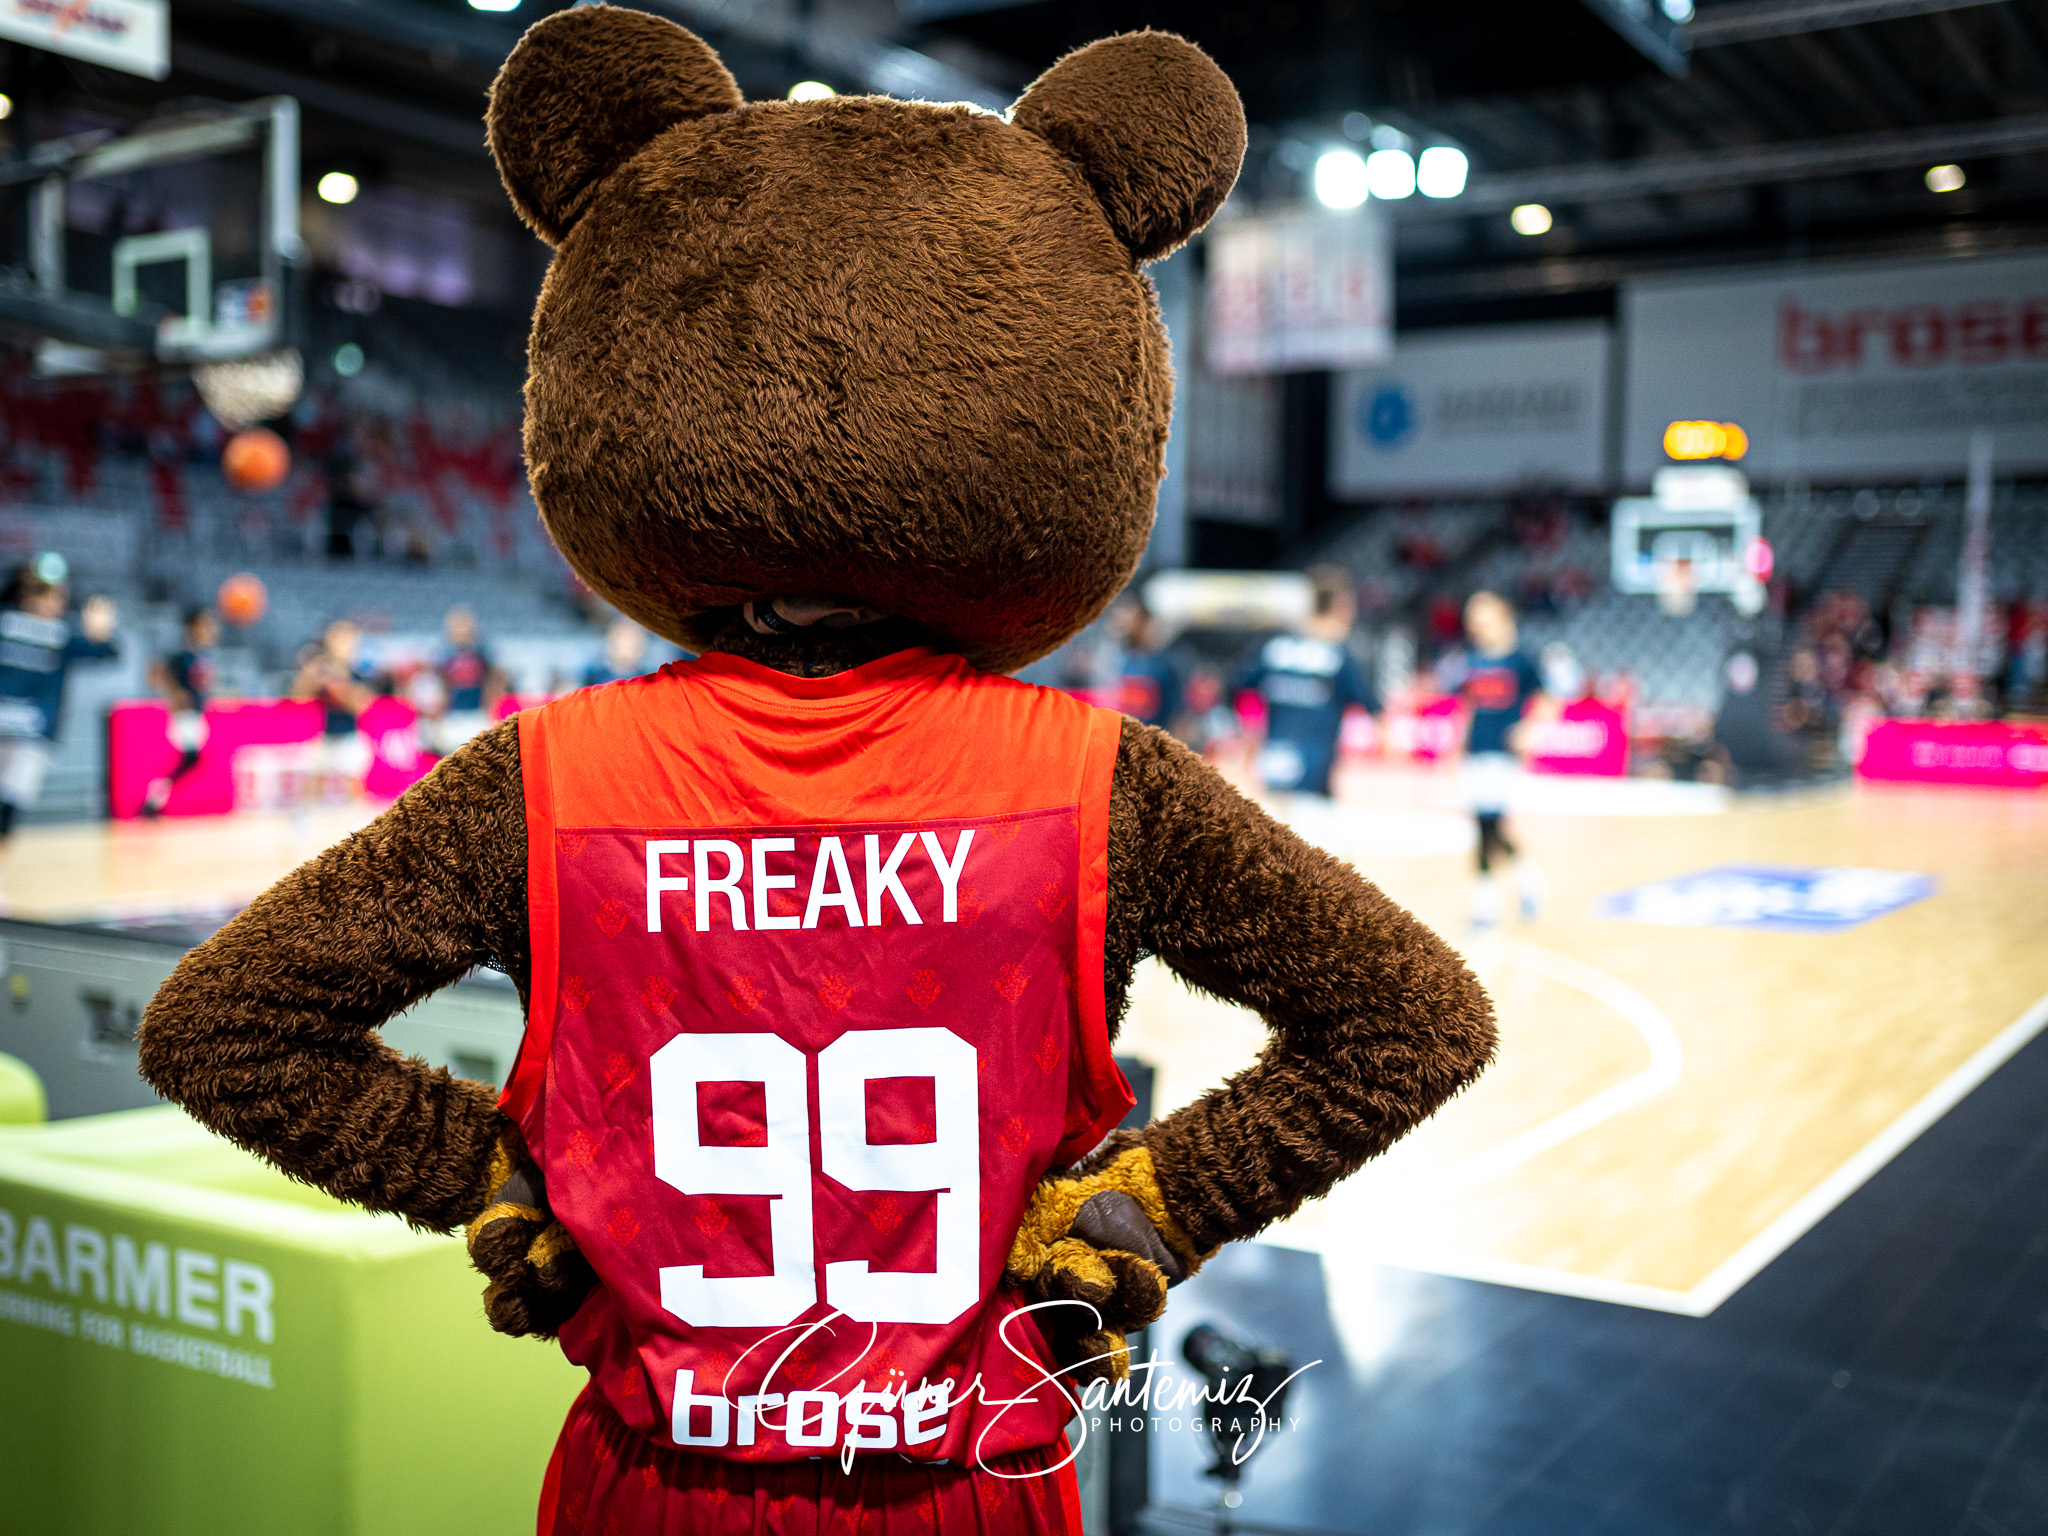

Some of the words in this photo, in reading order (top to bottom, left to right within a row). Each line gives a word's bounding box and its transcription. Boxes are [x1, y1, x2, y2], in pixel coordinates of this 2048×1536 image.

[645, 830, 976, 933] FREAKY
[649, 1027, 981, 1327] 99
[672, 1369, 949, 1448] brose
